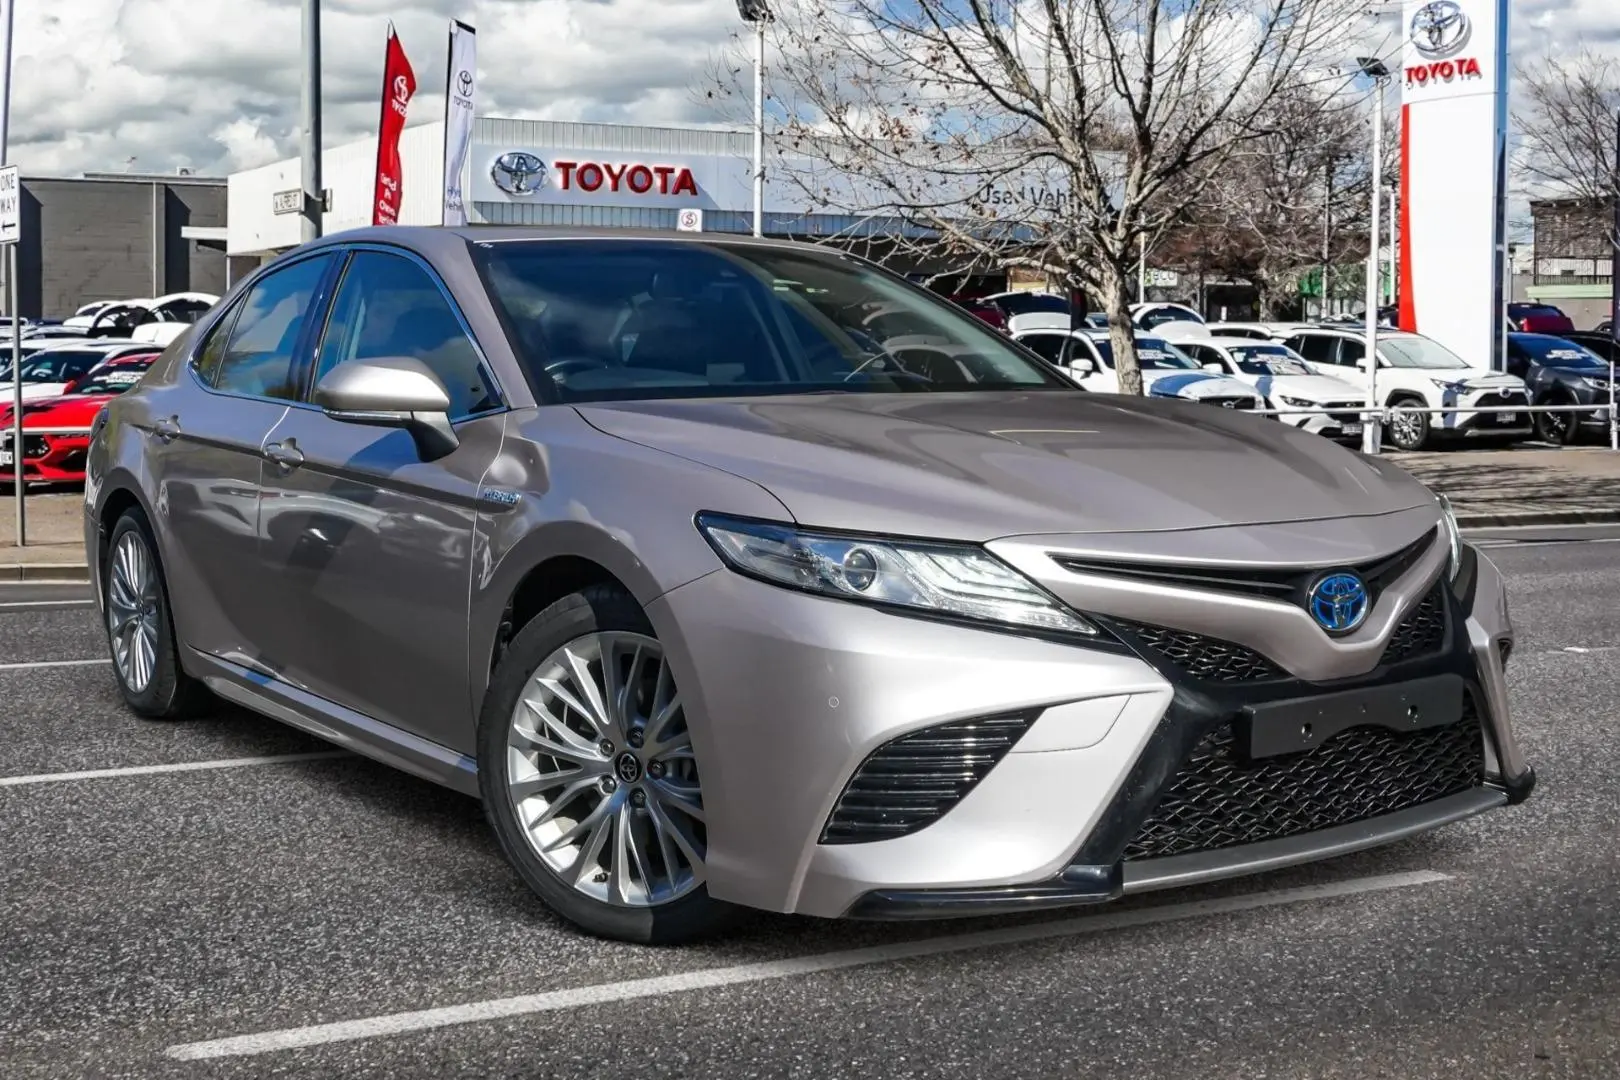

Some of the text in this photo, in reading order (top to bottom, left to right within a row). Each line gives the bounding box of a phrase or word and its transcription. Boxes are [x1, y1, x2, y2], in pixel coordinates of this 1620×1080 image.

[1404, 58, 1481, 83] TOYOTA
[1, 173, 15, 191] ONE
[555, 161, 698, 196] TOYOTA
[0, 196, 16, 213] WAY
